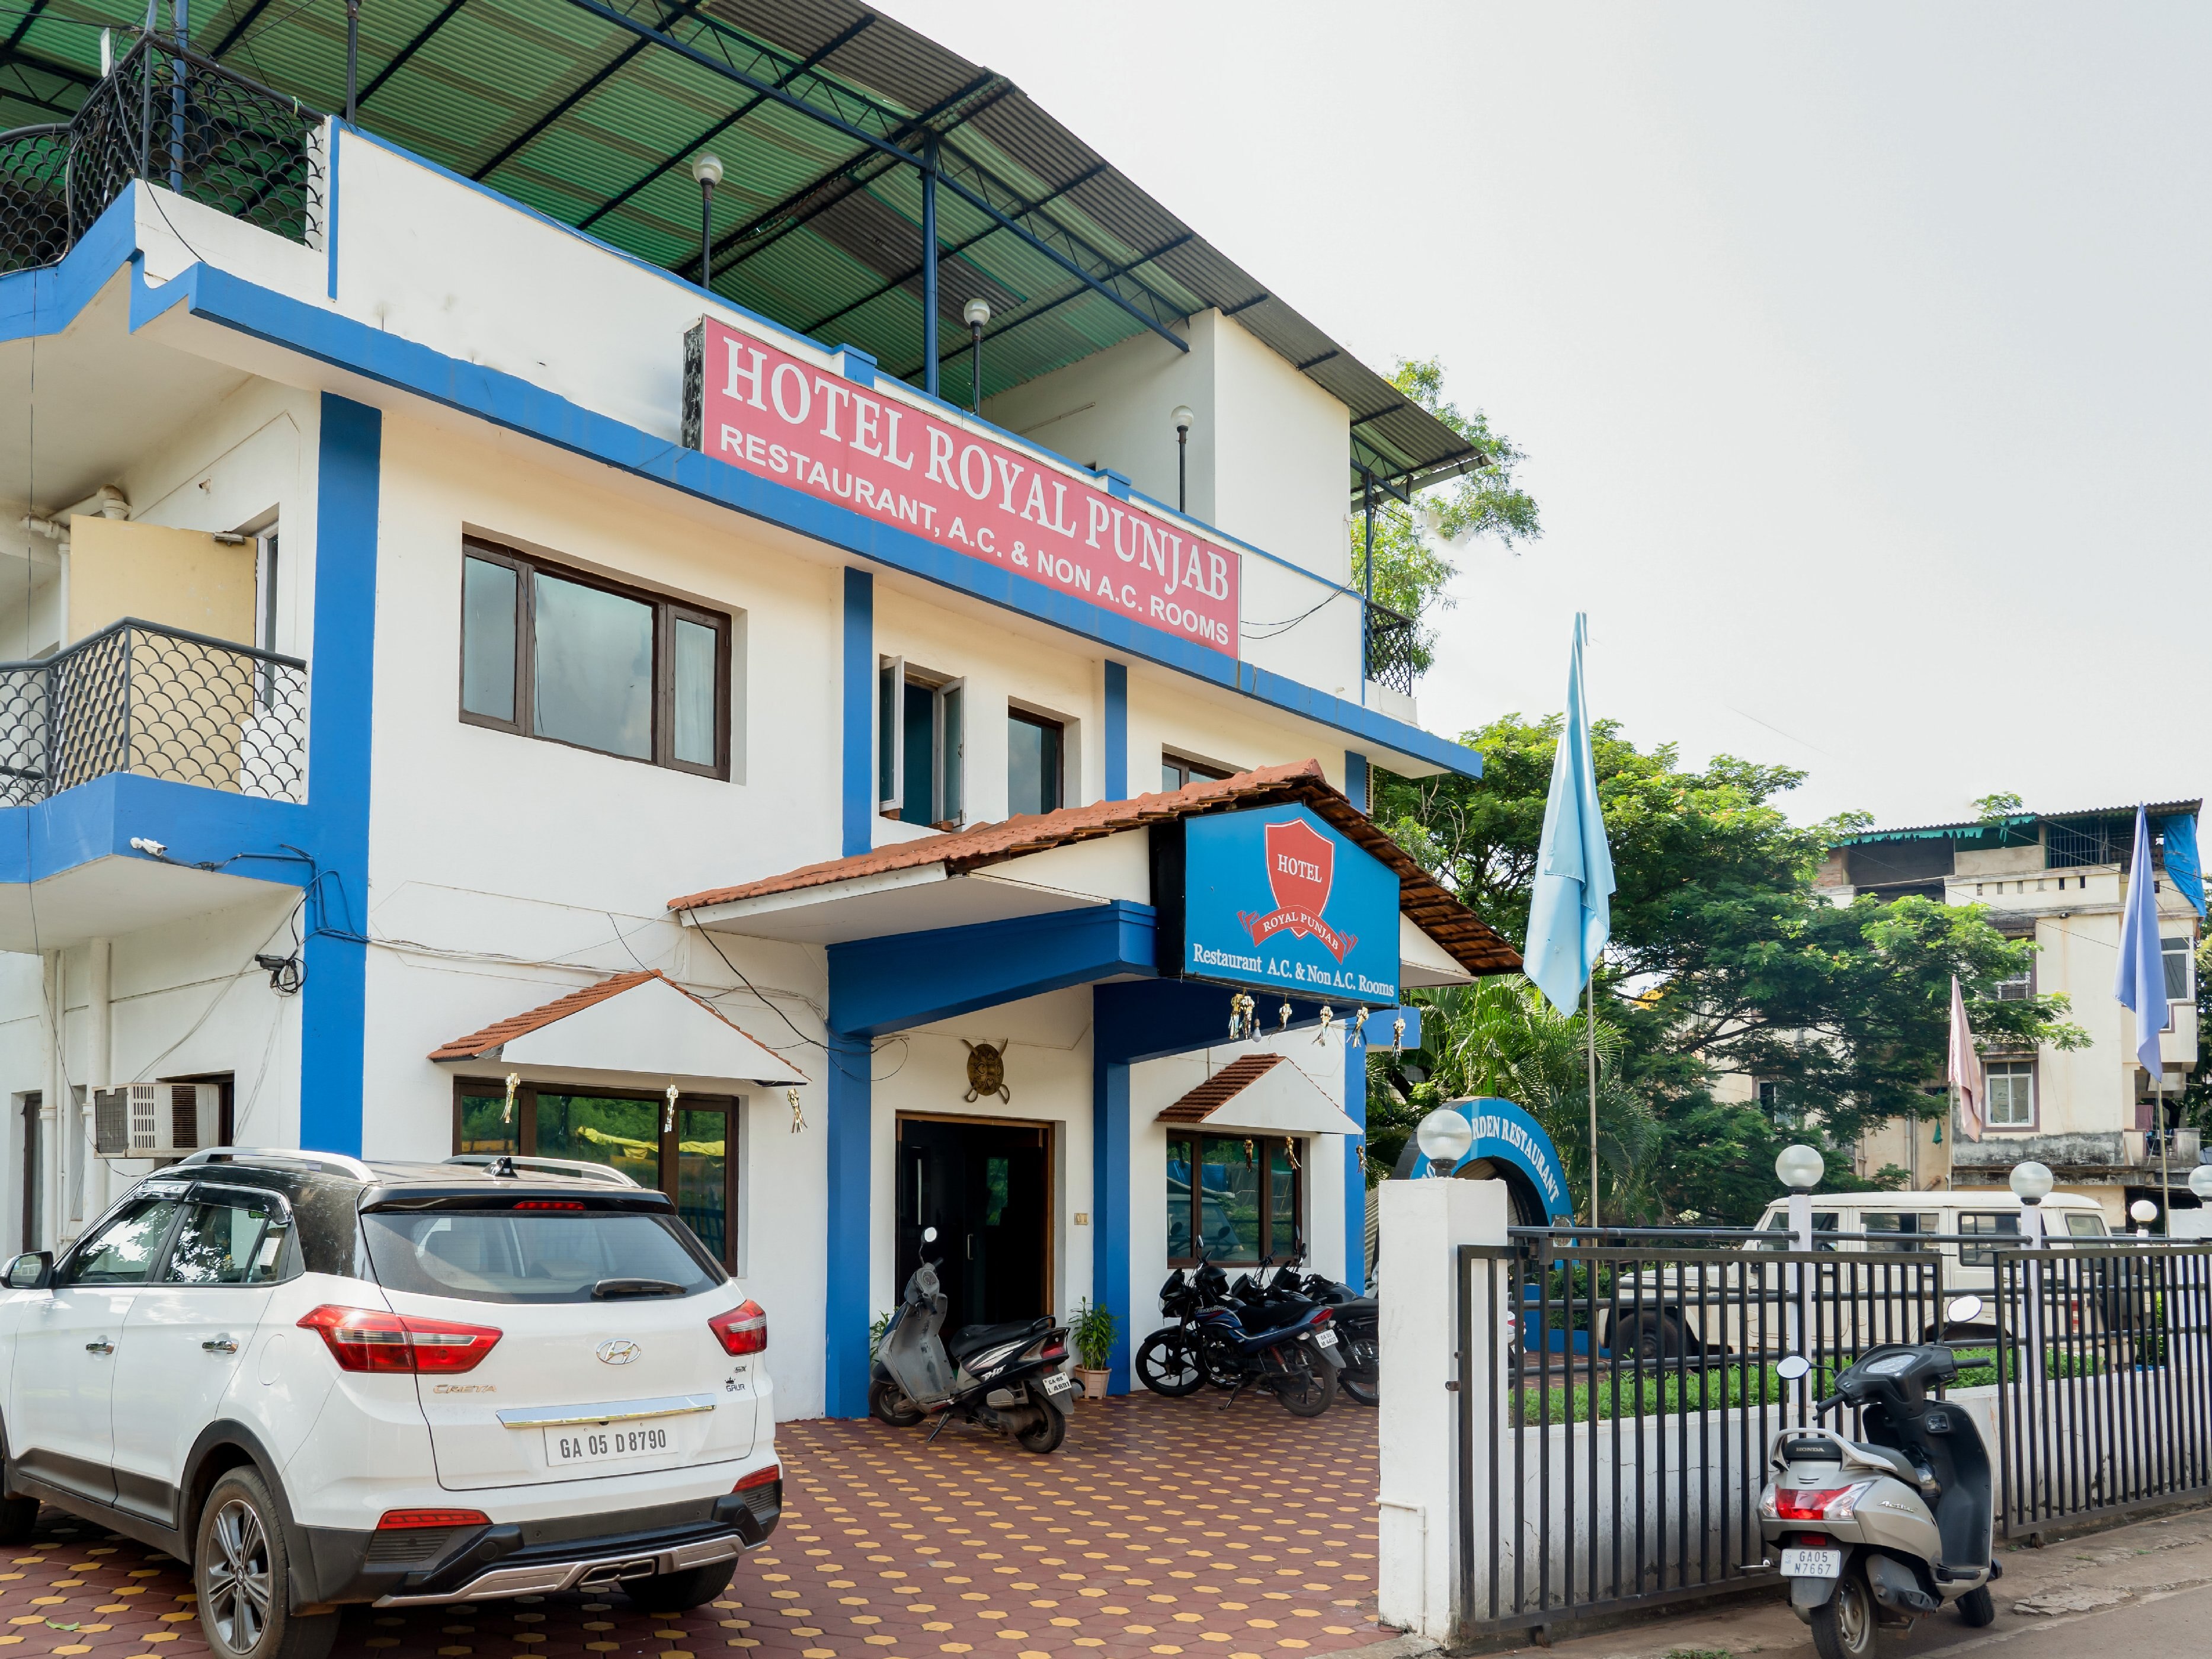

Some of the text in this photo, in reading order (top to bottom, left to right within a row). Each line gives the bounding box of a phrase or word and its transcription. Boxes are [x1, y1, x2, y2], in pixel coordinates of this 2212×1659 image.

[722, 336, 1228, 601] HOTEL ROYAL PUNJAB
[721, 423, 1229, 646] RESTAURANT, A.C. & NON A.C. ROOMS
[1277, 853, 1323, 883] HOTEL
[1263, 912, 1339, 950] ROYAL PUNJAB
[1193, 943, 1394, 997] Restaurant A.C. & Non A.C. Rooms
[1471, 1115, 1560, 1203] RDEN RESTAURANT
[433, 1384, 497, 1394] CRETA
[726, 1383, 745, 1392] GAUR
[560, 1439, 582, 1458] GA
[588, 1434, 607, 1455] 05
[628, 1429, 666, 1451] 8790
[1795, 1563, 1831, 1575] N7667
[1800, 1551, 1827, 1562] GA05
